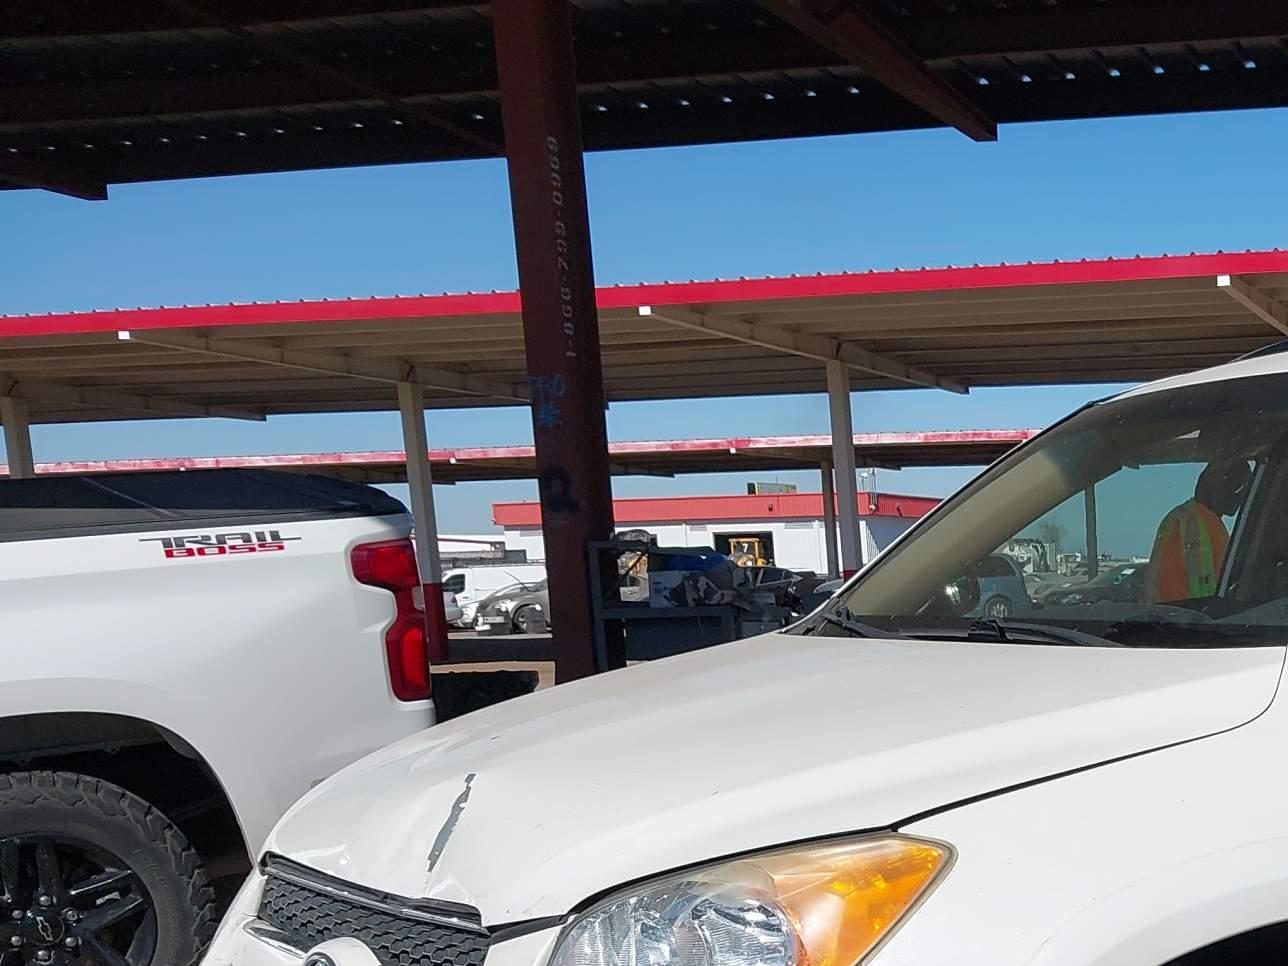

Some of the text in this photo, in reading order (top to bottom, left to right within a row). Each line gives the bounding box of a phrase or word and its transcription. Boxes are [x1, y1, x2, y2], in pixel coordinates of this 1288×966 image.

[139, 530, 302, 547] TRAIL
[164, 543, 285, 558] BOSS
[742, 543, 748, 552] 7
